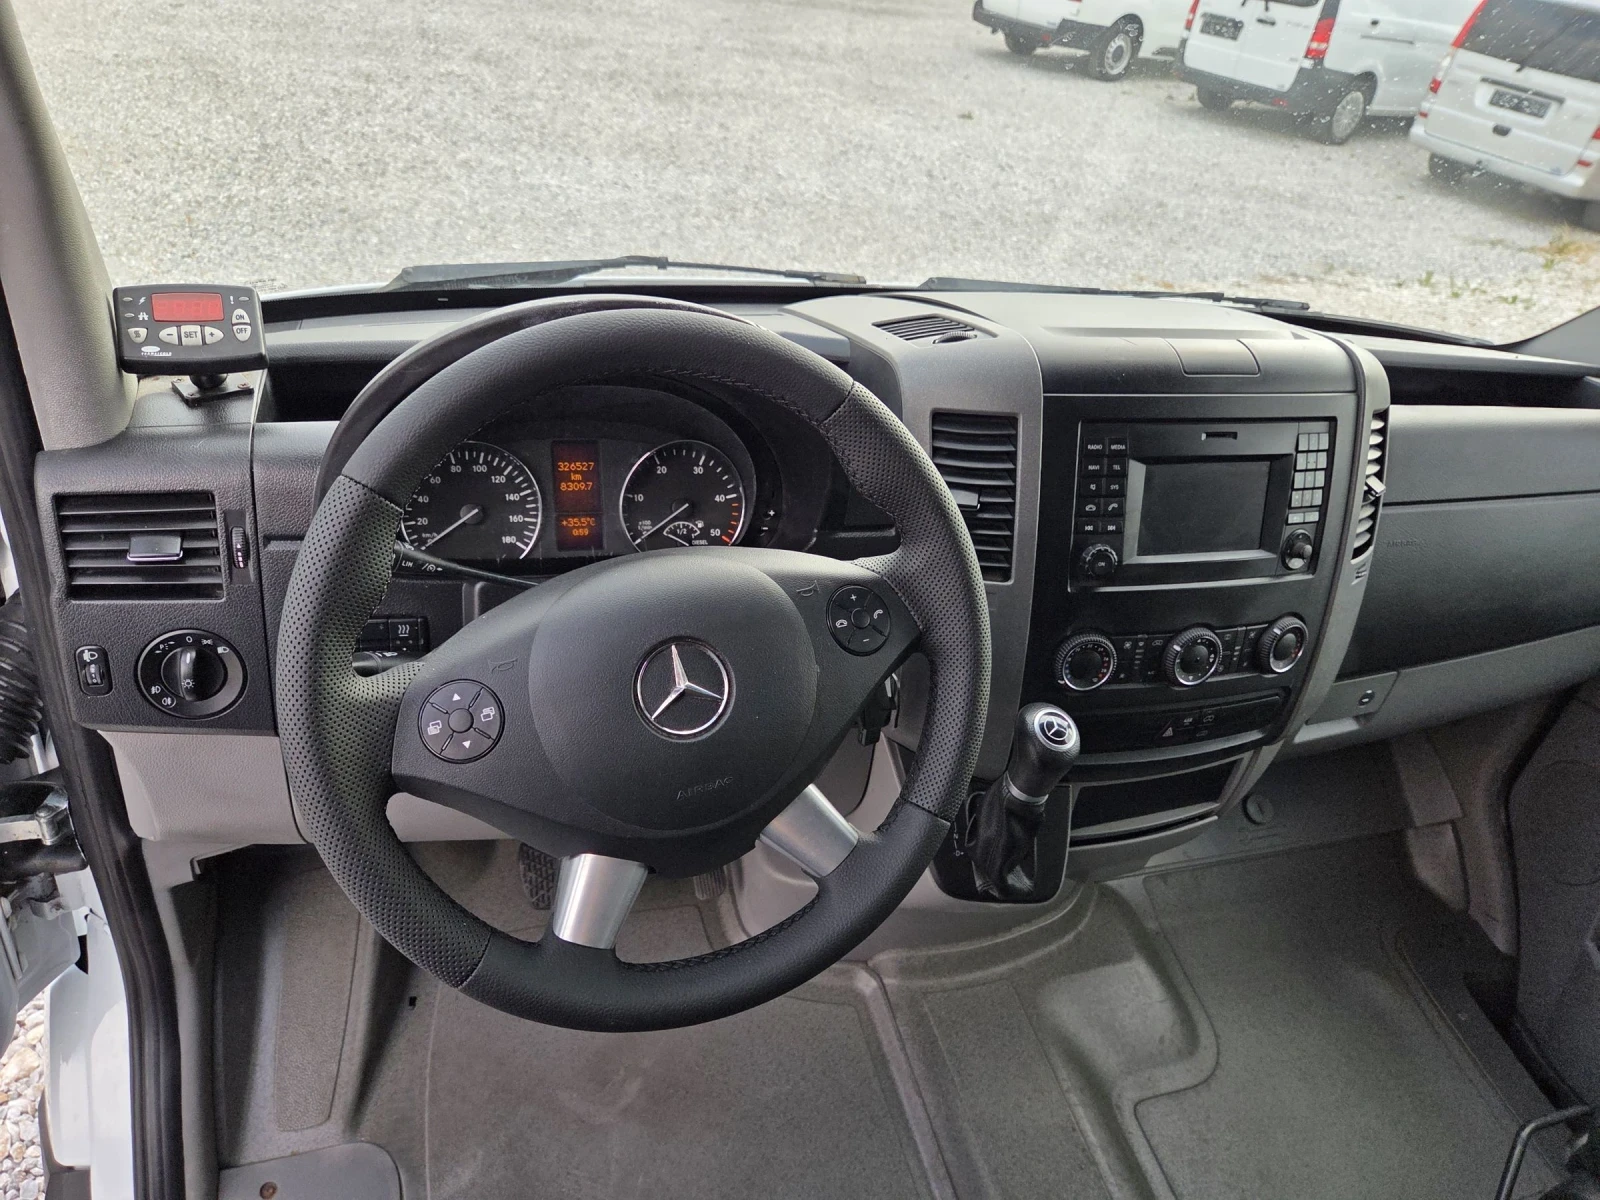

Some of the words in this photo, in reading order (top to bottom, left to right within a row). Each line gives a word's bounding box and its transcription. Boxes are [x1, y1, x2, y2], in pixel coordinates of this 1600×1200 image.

[183, 331, 198, 339] SET
[451, 465, 462, 473] 80
[472, 465, 488, 473] 100
[557, 462, 595, 471] 326527
[656, 466, 667, 474] 20
[693, 466, 704, 475] 30
[430, 476, 441, 484] 60
[491, 475, 506, 483] 120
[560, 482, 593, 491] 8309.7
[417, 495, 429, 503] 40
[505, 493, 520, 501] 140
[634, 494, 644, 502] 10
[714, 495, 726, 503] 40
[509, 515, 524, 523] 160
[710, 528, 721, 537] 50
[502, 536, 517, 544] 180
